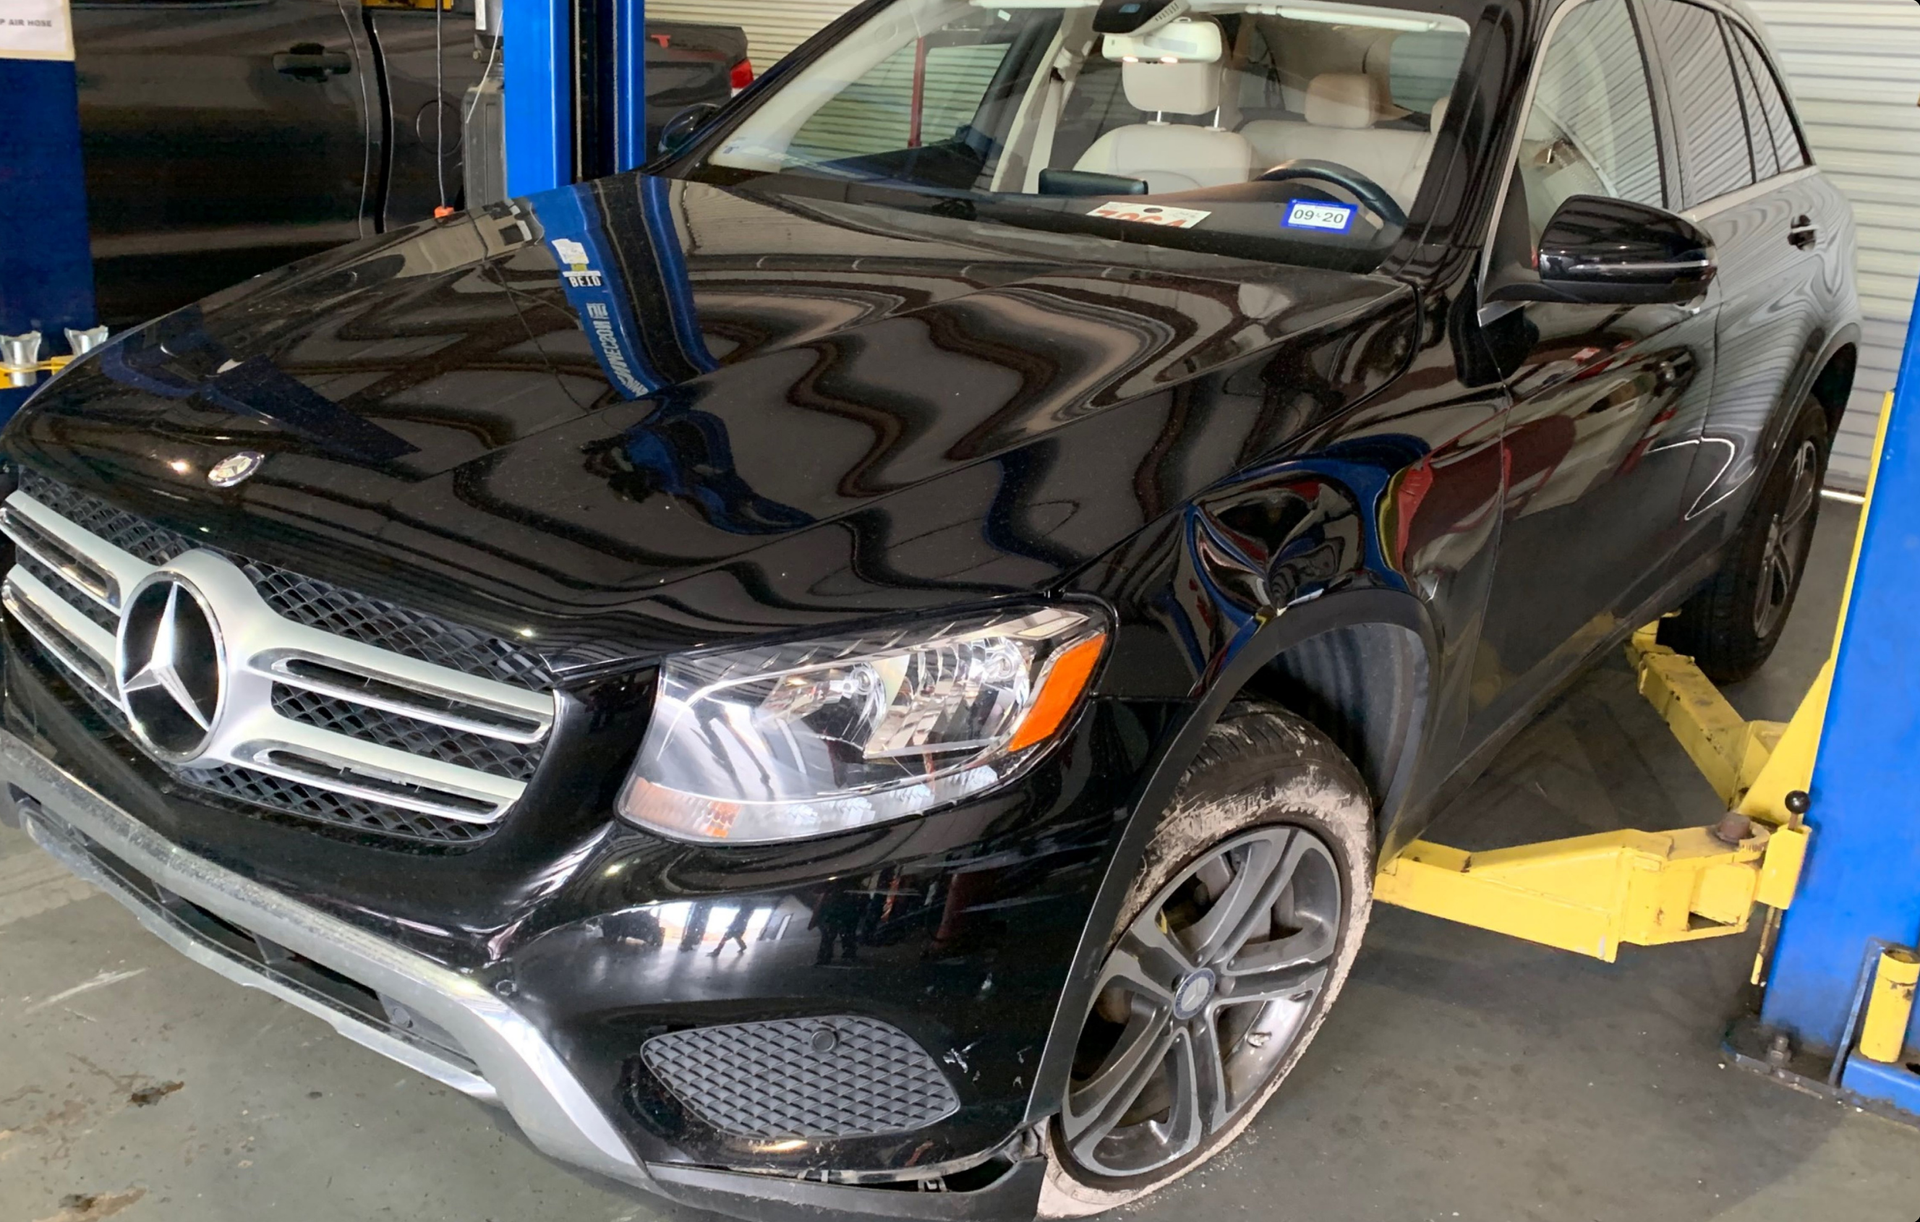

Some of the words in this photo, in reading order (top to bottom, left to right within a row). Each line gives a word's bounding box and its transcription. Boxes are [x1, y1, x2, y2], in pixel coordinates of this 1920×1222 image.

[8, 18, 25, 26] AIR
[1293, 209, 1315, 221] 09
[1322, 212, 1345, 224] 20
